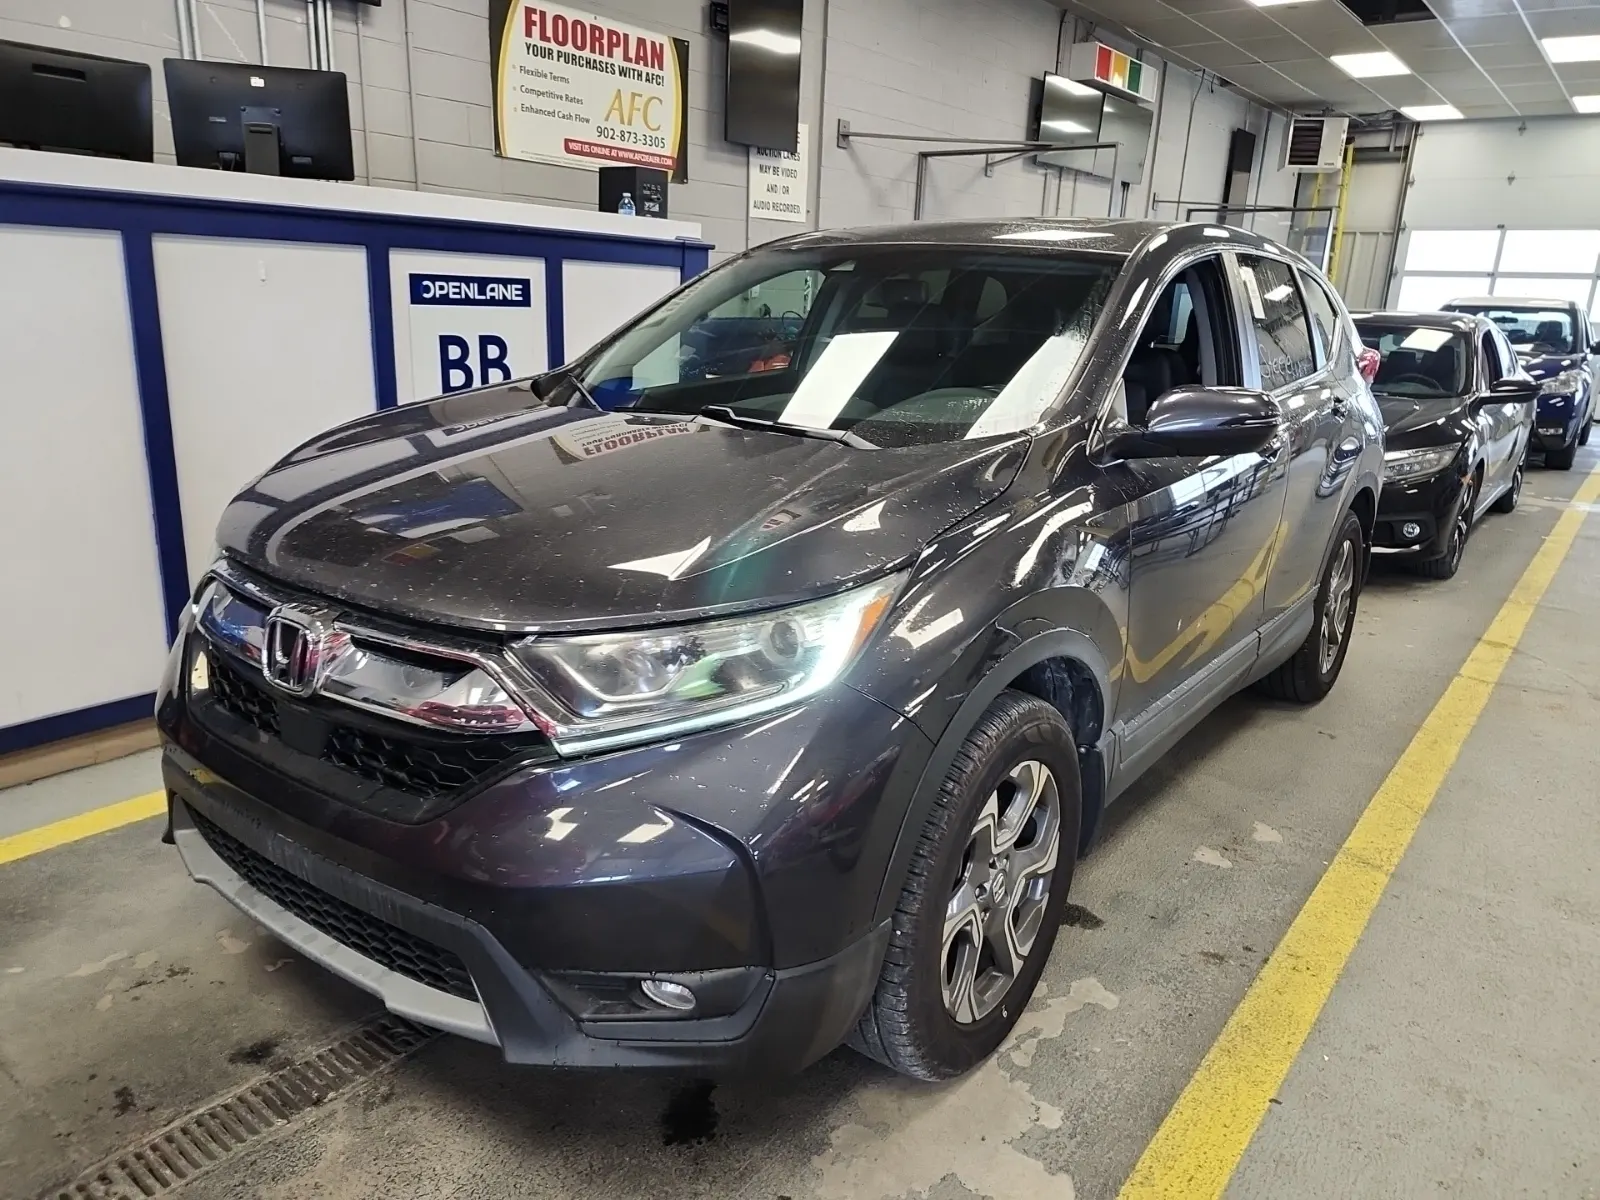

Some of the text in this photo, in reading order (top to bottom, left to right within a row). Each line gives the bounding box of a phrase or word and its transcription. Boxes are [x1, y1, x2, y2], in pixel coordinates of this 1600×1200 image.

[524, 6, 664, 71] FLOORPLAN
[519, 65, 570, 84] Flexible Terms
[525, 42, 665, 87] YOUR PURCHASES WITH AFC!
[520, 85, 584, 105] Competitive Rates
[521, 104, 590, 124] Enhanced Cash Flow
[604, 88, 663, 132] AFC
[596, 125, 666, 149] 902-873-3305
[568, 141, 581, 151] VISIT
[582, 144, 590, 152] US
[590, 145, 610, 156] ONLINE
[759, 164, 798, 179] MAY BE VIDEO
[766, 184, 777, 194] AND
[782, 185, 790, 195] OR
[753, 200, 771, 210] AUDIO
[421, 280, 523, 300] OPENLANE
